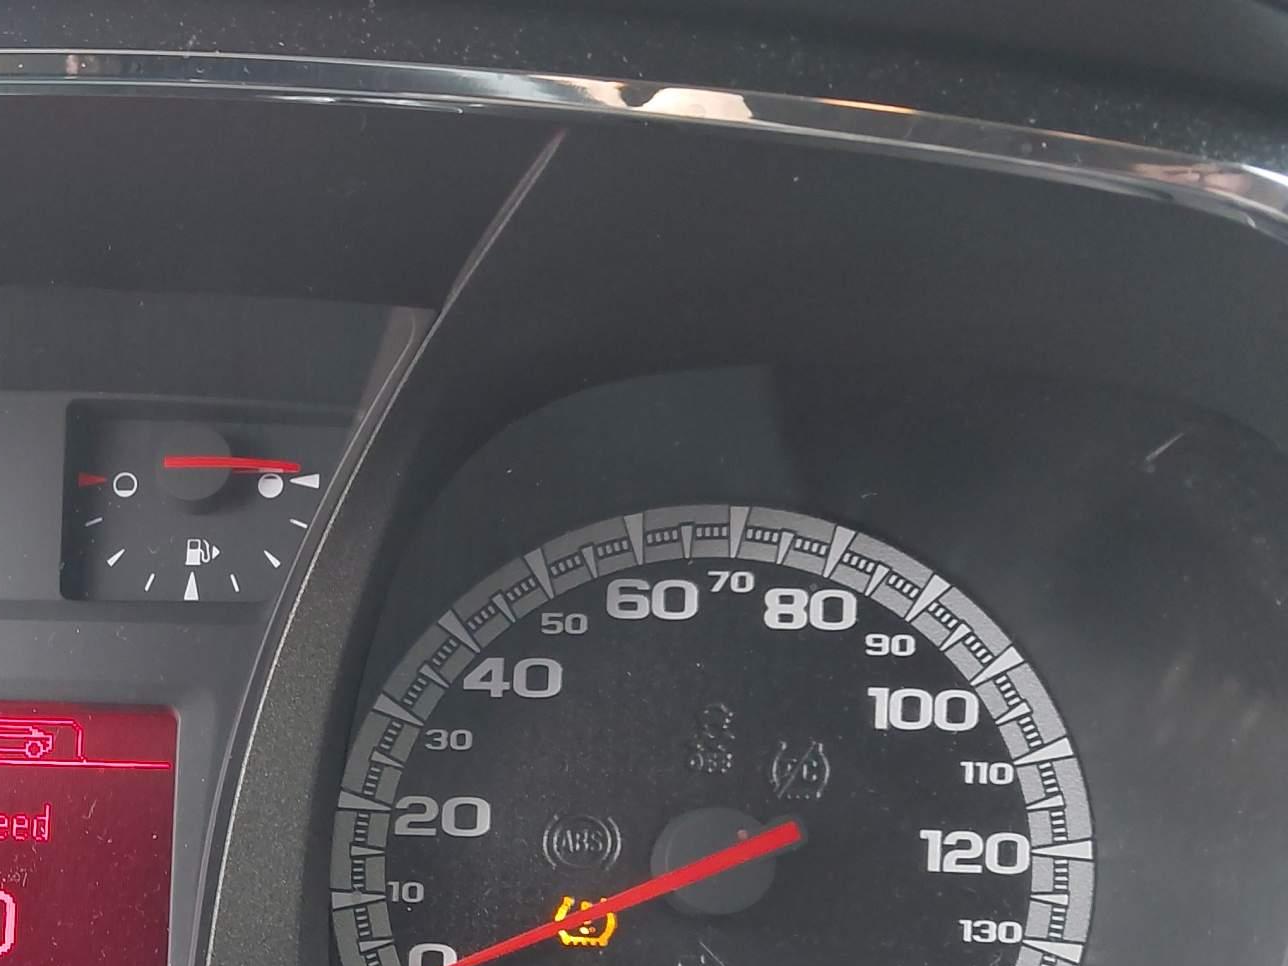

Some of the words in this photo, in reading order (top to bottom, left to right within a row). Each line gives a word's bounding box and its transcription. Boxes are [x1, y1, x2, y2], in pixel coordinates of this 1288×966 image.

[707, 571, 755, 593] 70
[606, 579, 699, 620] 60
[763, 588, 858, 631] 80
[541, 613, 588, 635] 50
[864, 633, 916, 657] 90
[463, 657, 563, 699] 40
[867, 687, 980, 732] 100
[424, 729, 473, 751] 30
[960, 761, 1014, 785] 110
[394, 796, 491, 837] 20
[919, 829, 1031, 875] 120
[387, 881, 424, 903] 10
[959, 919, 1023, 944] 130
